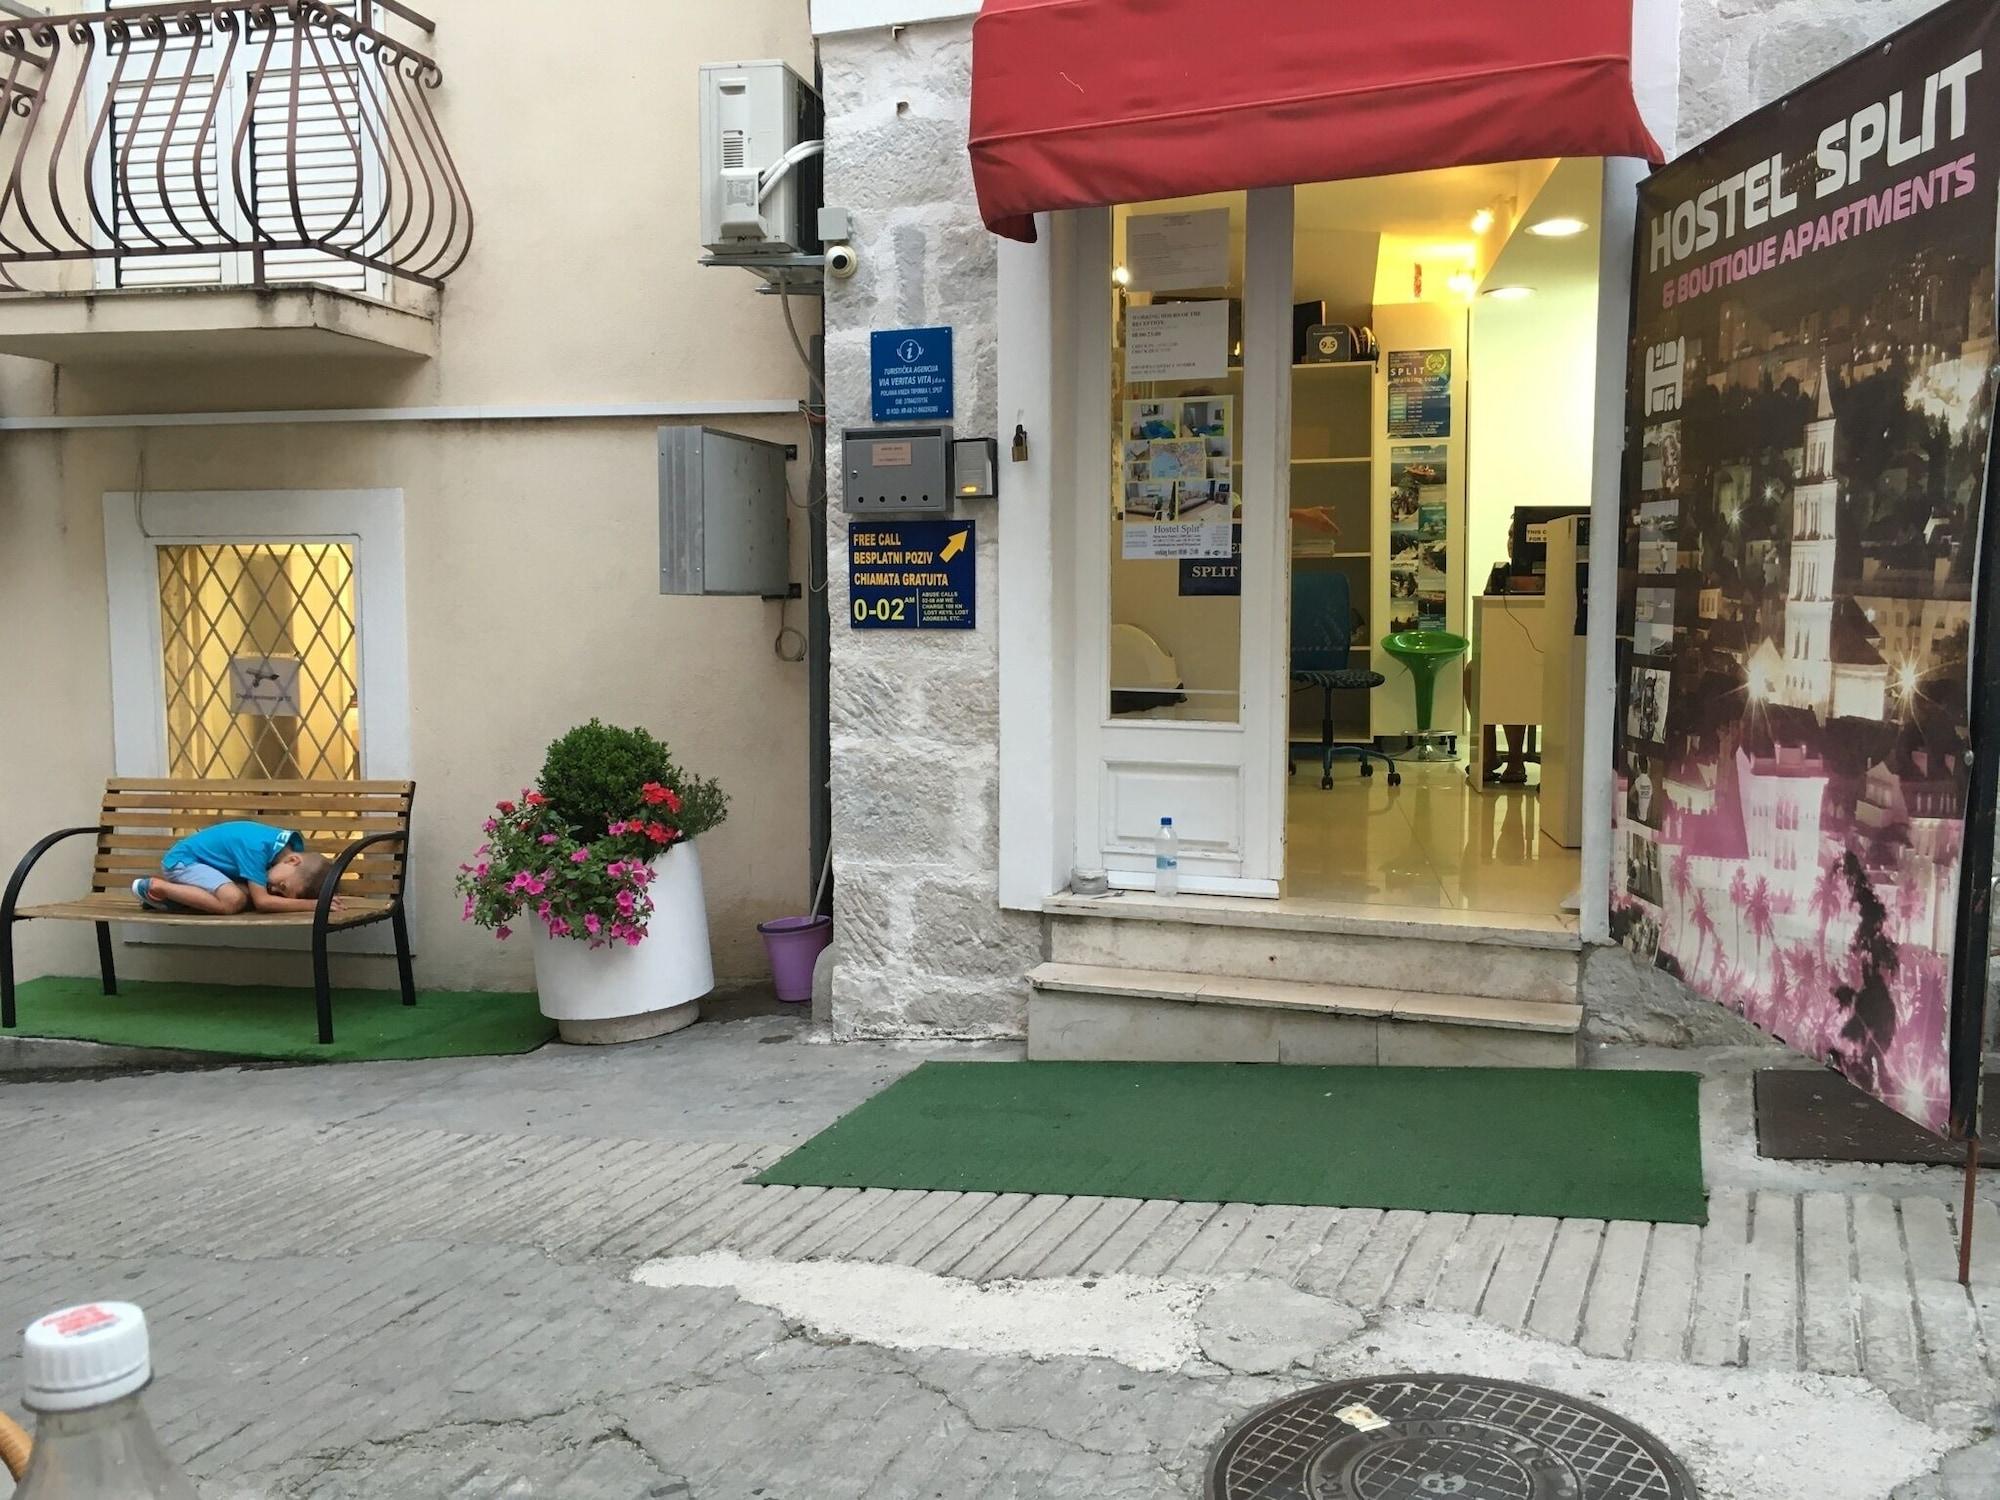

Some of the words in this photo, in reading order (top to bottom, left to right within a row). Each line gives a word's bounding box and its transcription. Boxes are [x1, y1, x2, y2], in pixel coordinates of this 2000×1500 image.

[1650, 152, 1797, 272] HOSTEL
[1815, 49, 1983, 199] SPLIT
[1677, 235, 1777, 305] BOUTIQUE
[1779, 153, 1976, 265] APARTMENTS
[1321, 341, 1335, 349] 9.5
[1390, 367, 1425, 376] SPLIT
[879, 378, 889, 387] VIA
[891, 376, 916, 386] VERITAS
[917, 375, 931, 384] VITA
[1154, 525, 1179, 533] Hostel
[853, 534, 876, 546] FREE
[878, 533, 901, 545] CALL
[853, 552, 903, 564] BESPLATNI
[905, 552, 933, 564] POZIV
[1192, 566, 1238, 577] SPLIT
[854, 573, 900, 585] CHIAMATA
[902, 573, 948, 585] GRATUITA
[853, 598, 904, 620] 0-02
